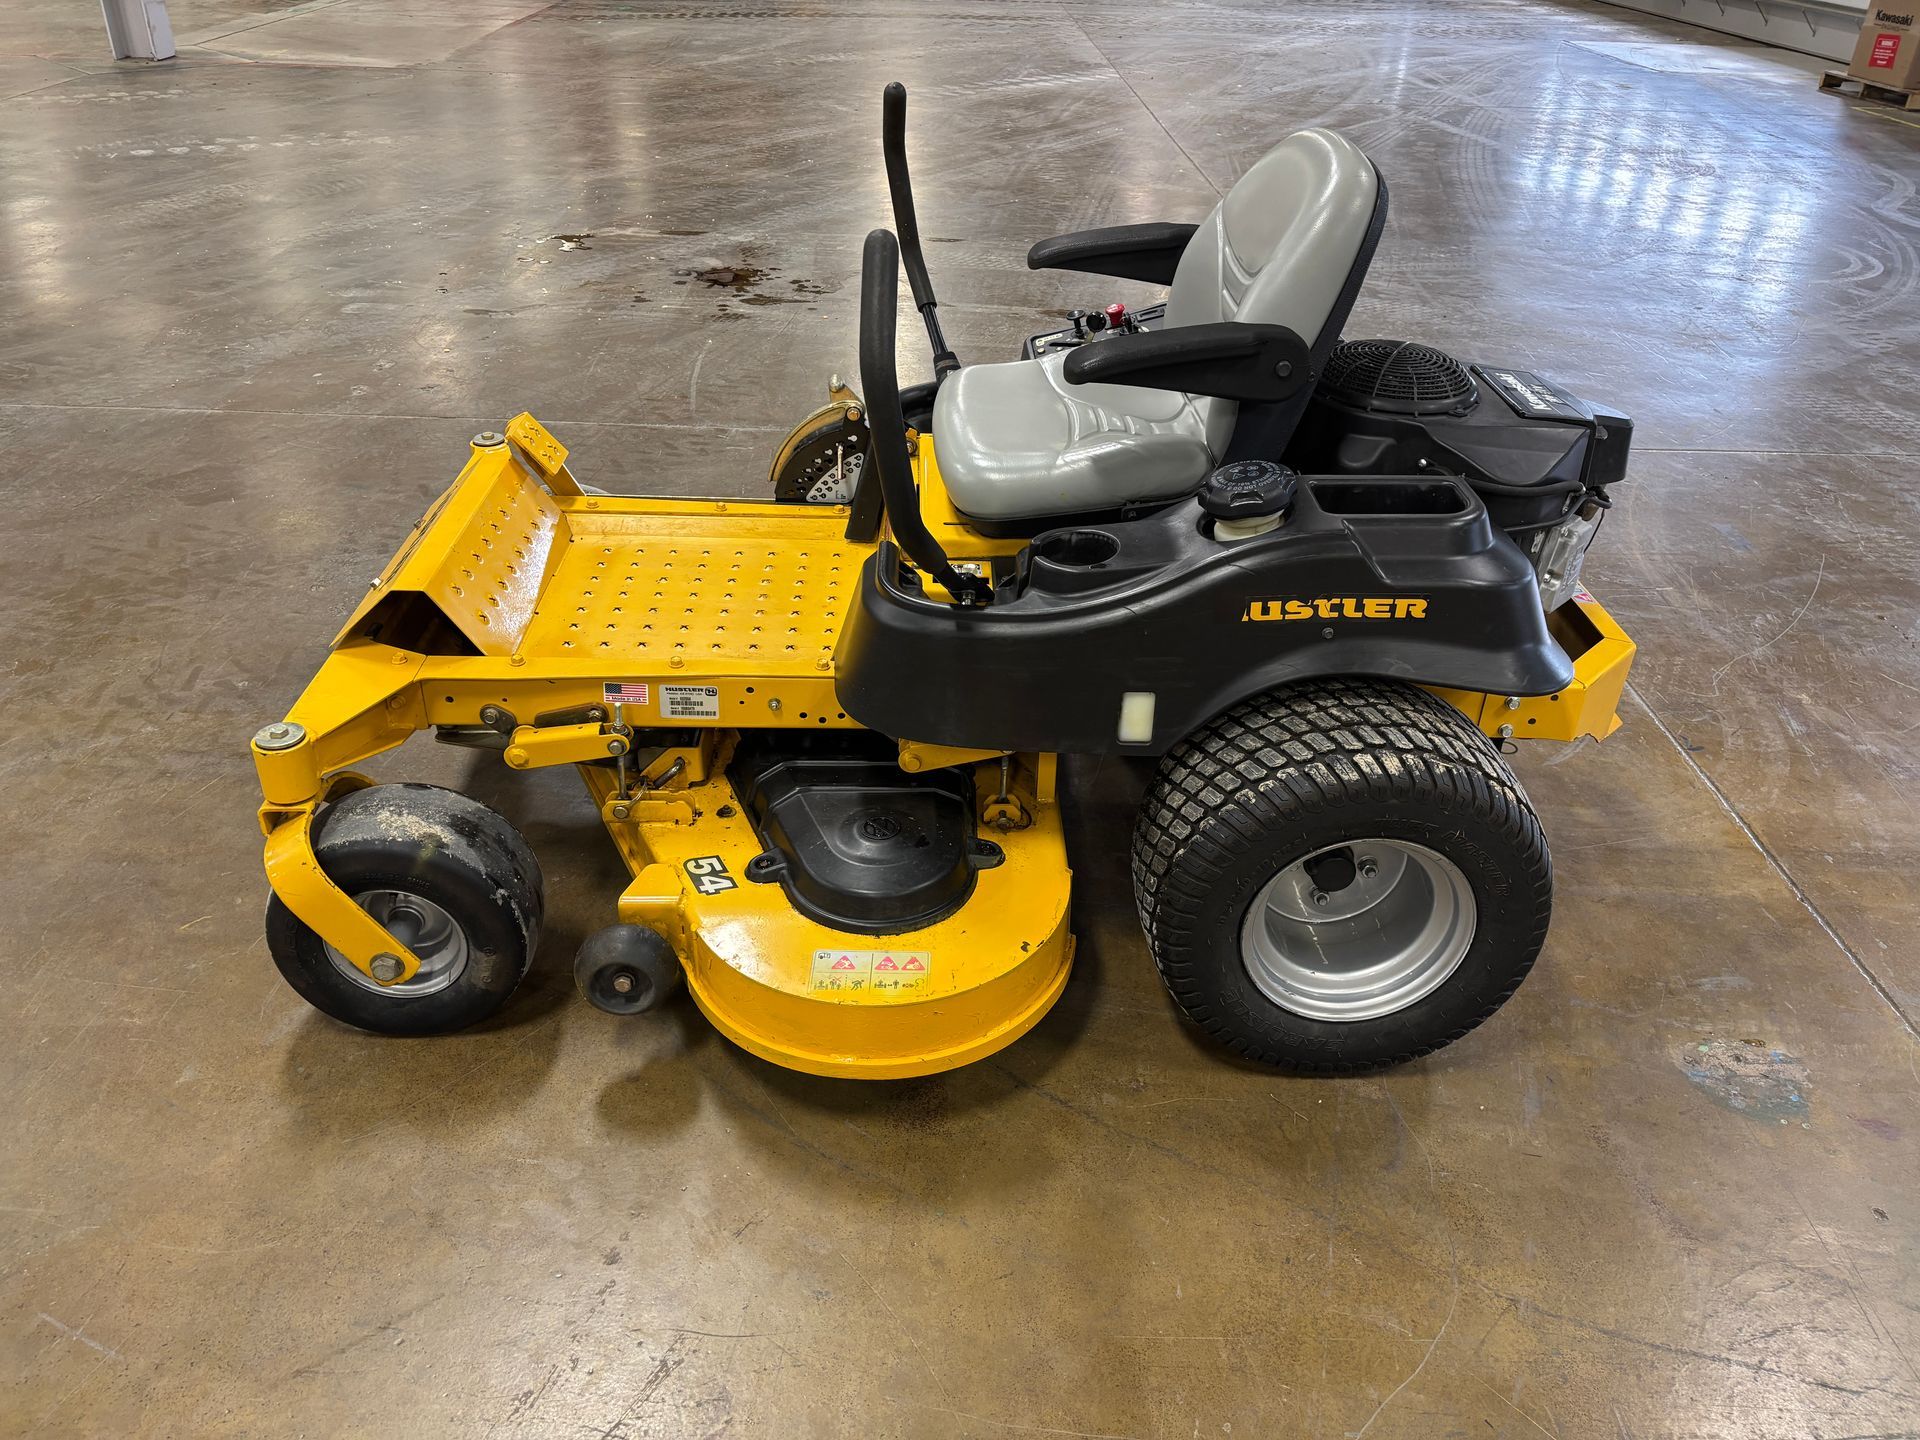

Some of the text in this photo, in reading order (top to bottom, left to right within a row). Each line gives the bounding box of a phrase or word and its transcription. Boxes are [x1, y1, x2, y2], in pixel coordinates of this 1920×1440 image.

[1875, 9, 1914, 26] Kawasaki
[1242, 598, 1429, 621] USTLER
[685, 856, 737, 894] 54
